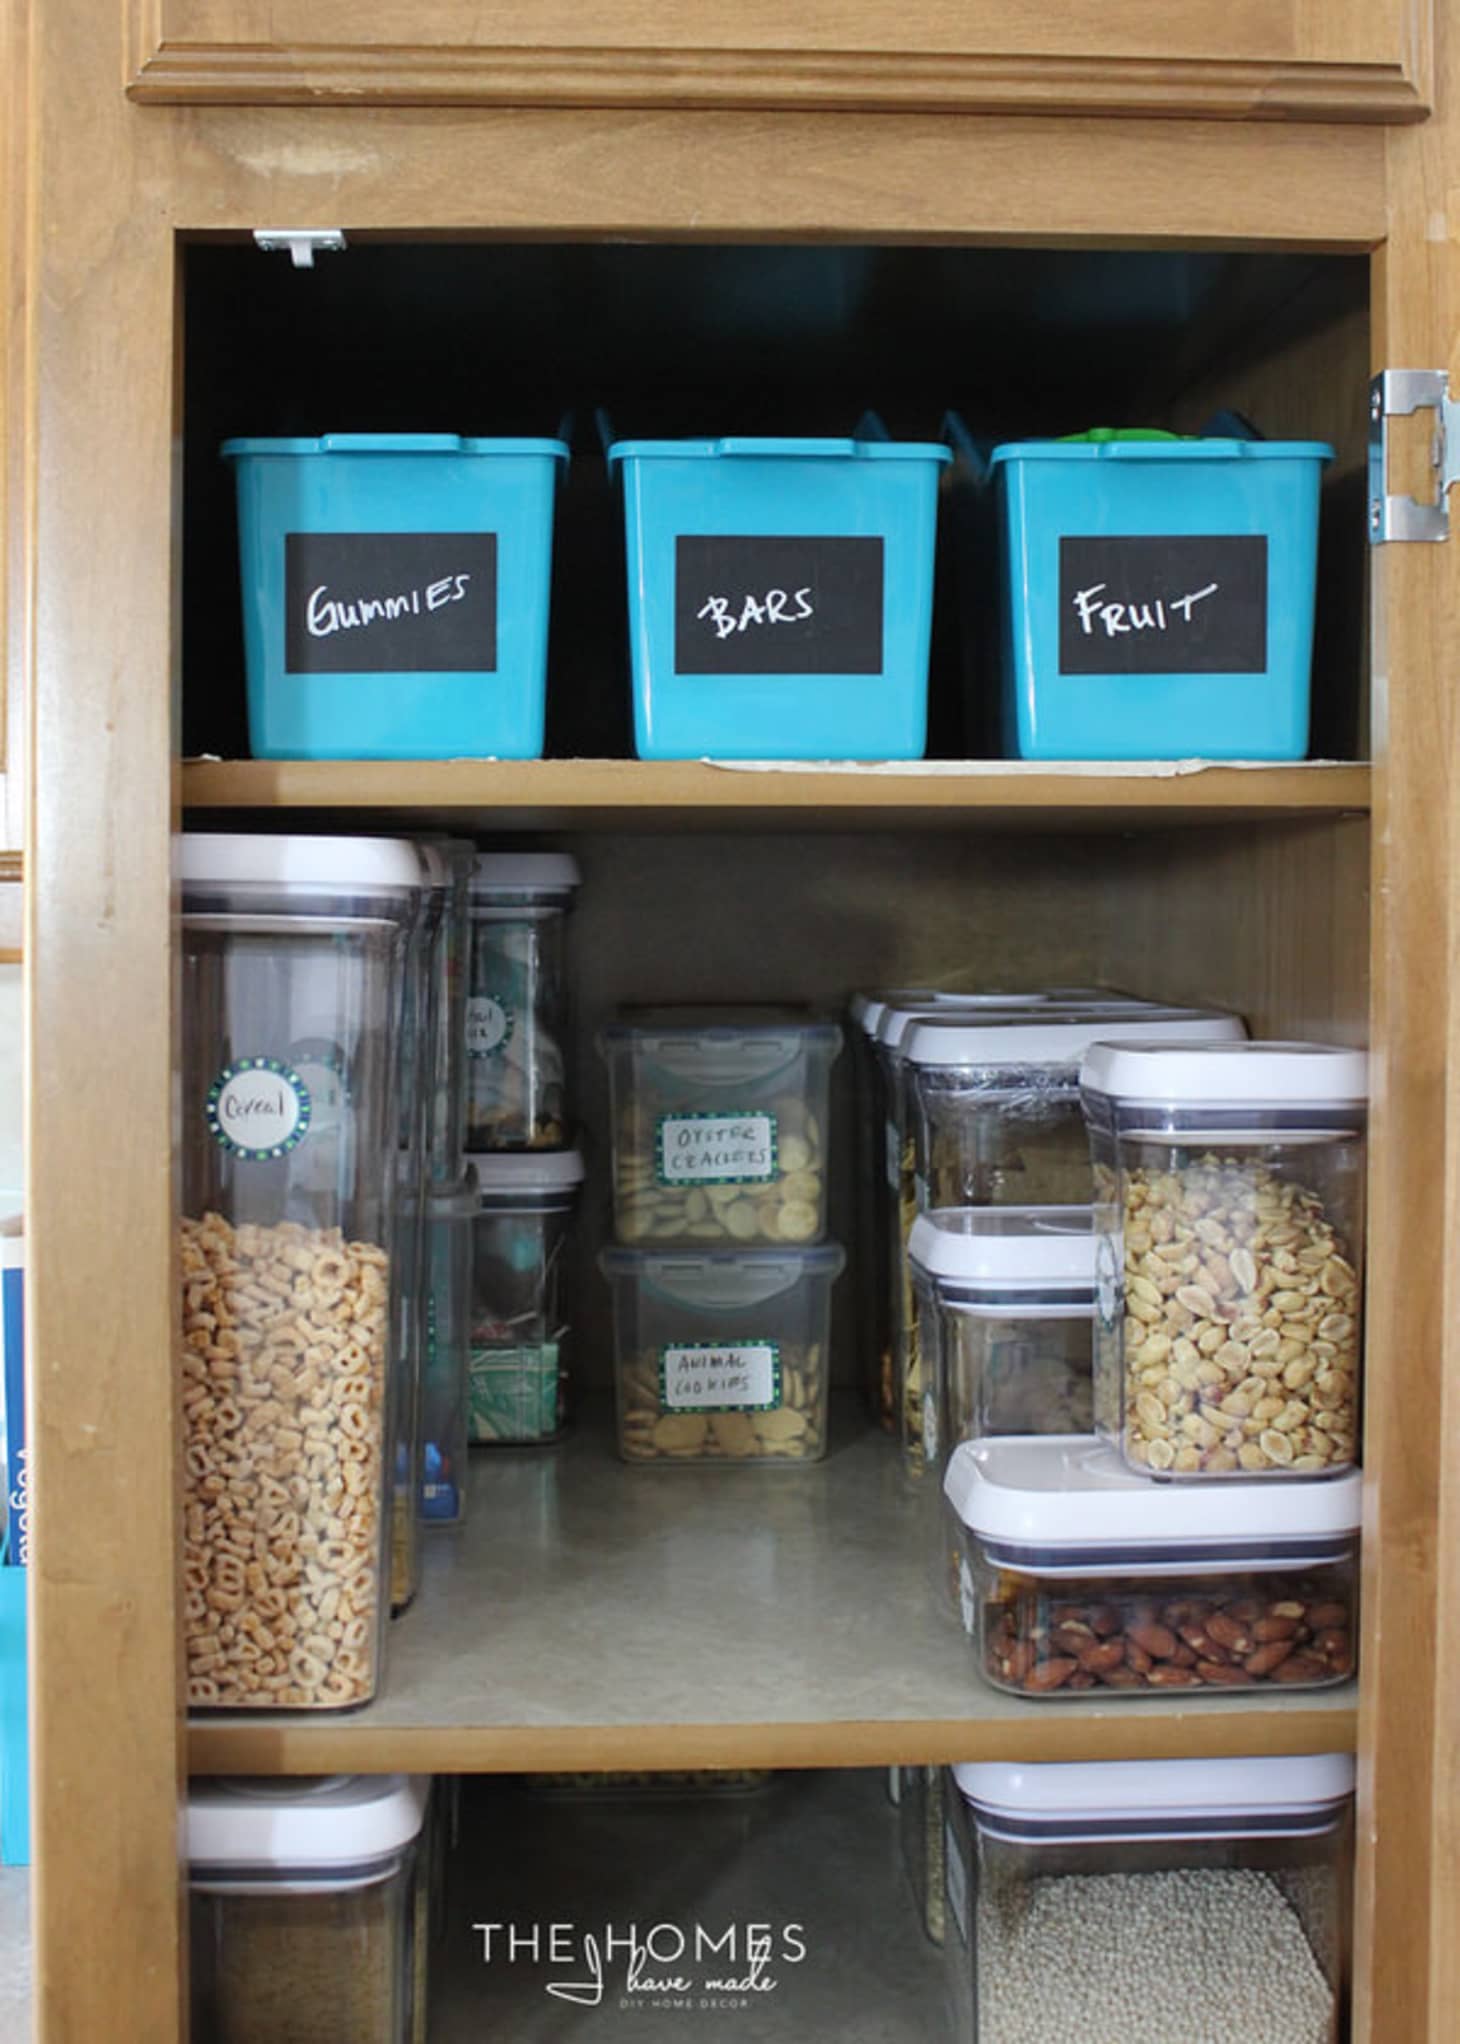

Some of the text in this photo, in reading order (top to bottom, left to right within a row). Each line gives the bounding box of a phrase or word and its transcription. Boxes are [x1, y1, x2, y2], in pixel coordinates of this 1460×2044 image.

[697, 588, 814, 639] BARS
[1073, 583, 1219, 637] FRUIT
[225, 1091, 284, 1119] Cereal
